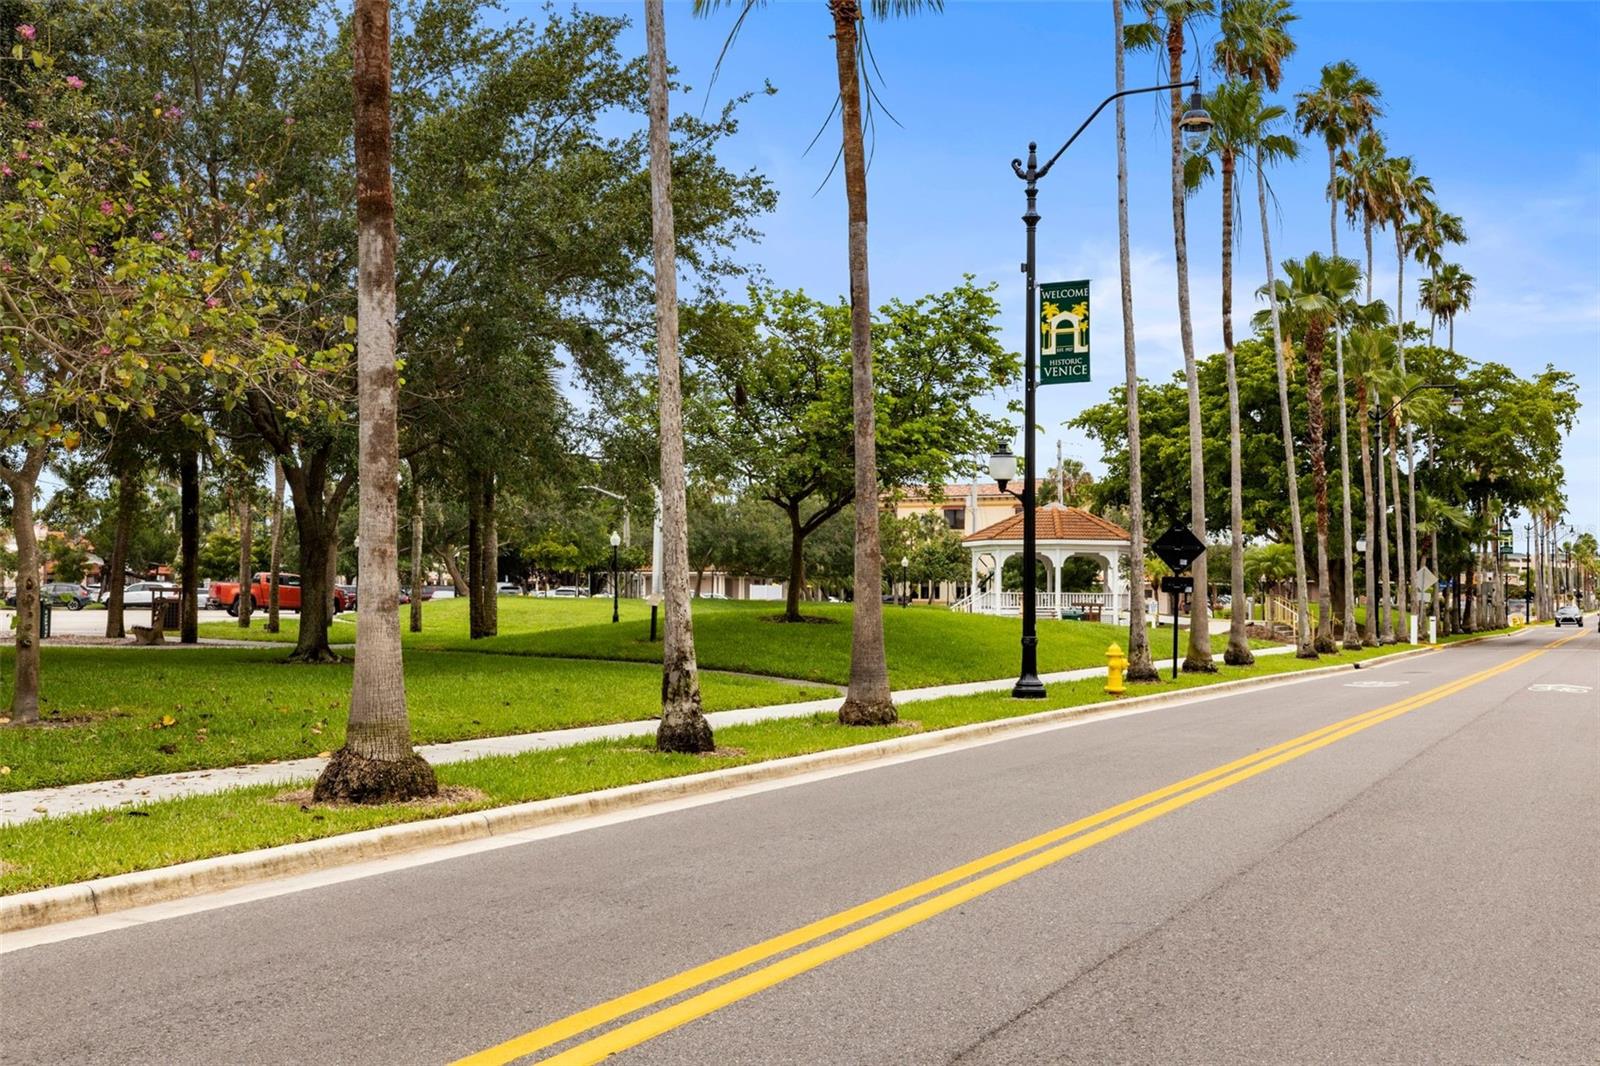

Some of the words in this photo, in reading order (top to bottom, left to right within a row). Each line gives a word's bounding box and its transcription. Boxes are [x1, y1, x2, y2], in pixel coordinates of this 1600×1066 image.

[1042, 288, 1088, 299] WELCOME
[1049, 358, 1082, 366] HISTORIC
[1043, 365, 1087, 377] VENICE
